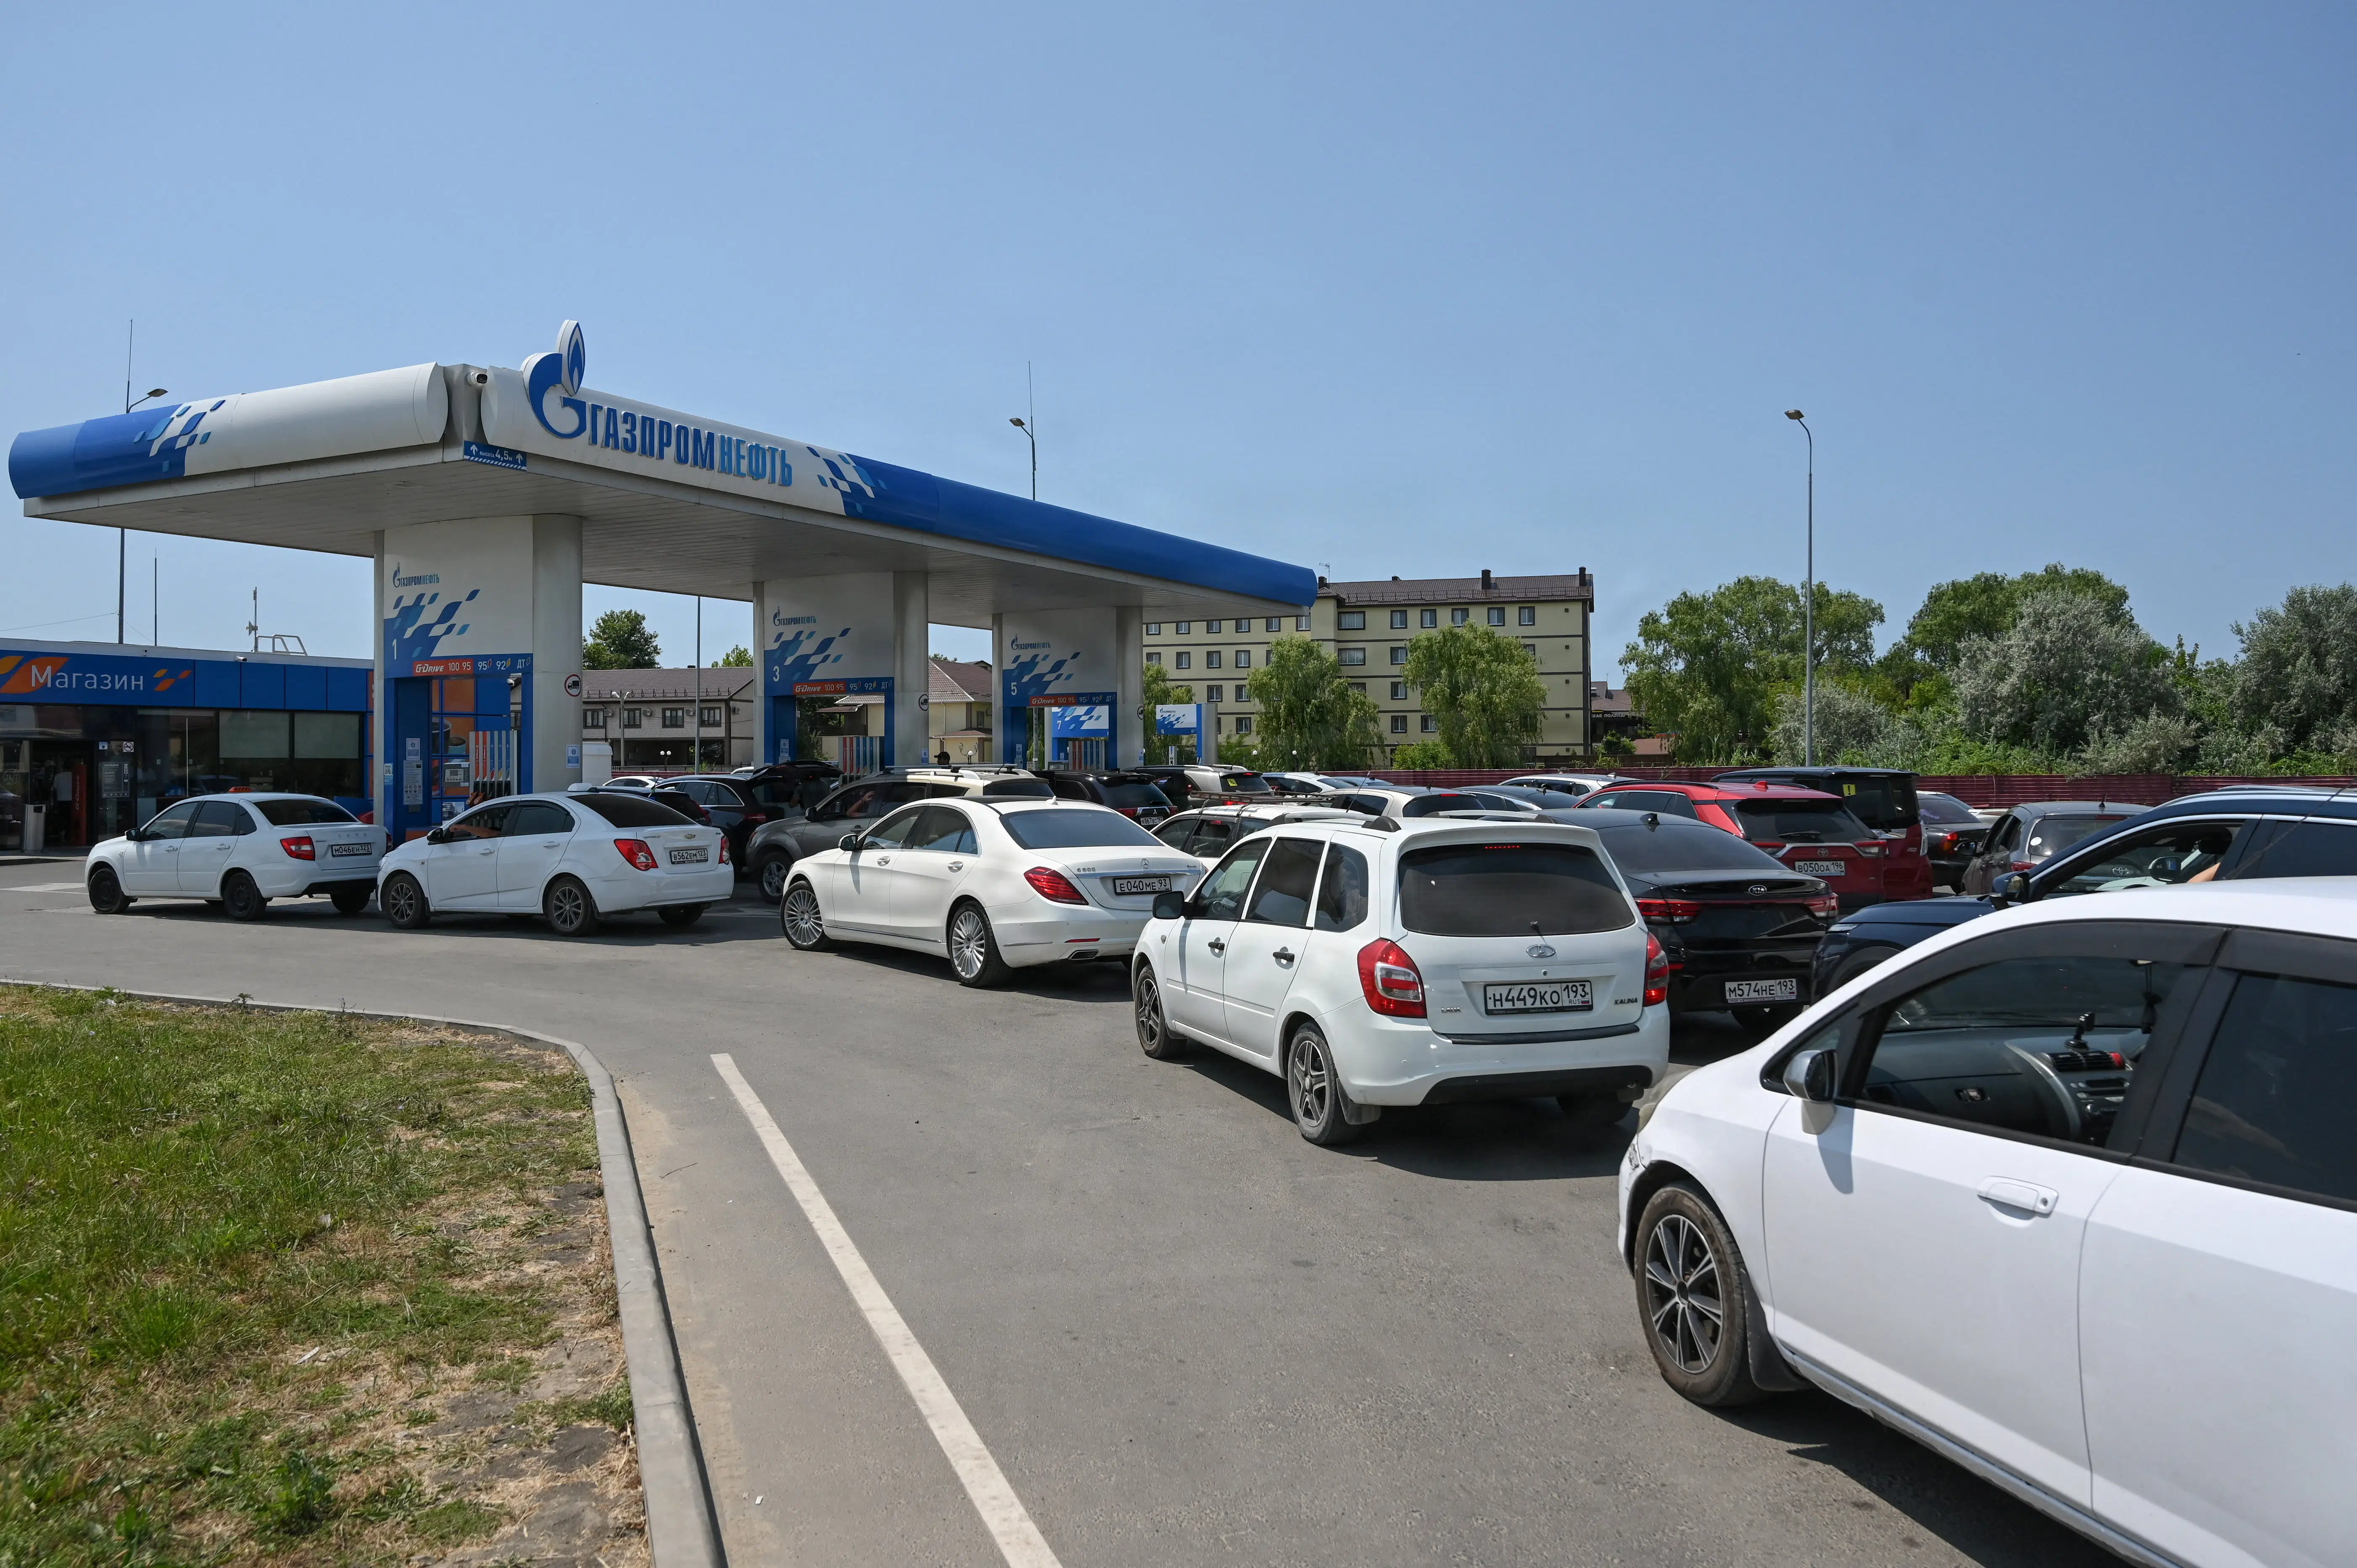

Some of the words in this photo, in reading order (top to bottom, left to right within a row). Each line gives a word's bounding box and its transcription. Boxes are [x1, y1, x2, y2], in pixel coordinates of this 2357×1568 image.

[588, 403, 792, 487] ГАЗПРОМНЕФТЬ
[401, 574, 440, 587] ГАЗПРОМНЕФТЬ
[781, 616, 816, 626] ГАЗПРОМНЕФТЬ
[392, 639, 397, 660] 1
[448, 662, 459, 672] 100
[462, 662, 471, 671] 95
[478, 661, 487, 671] 95
[496, 661, 506, 670] 92
[517, 659, 525, 669] ДТ
[31, 665, 143, 690] Магазин
[773, 666, 780, 682] 3
[1011, 682, 1017, 696] 5
[1057, 720, 1062, 730] 7
[674, 851, 696, 860] В562ЕМ
[1120, 880, 1156, 892] Е040МЕ
[1158, 879, 1167, 887] 93
[1492, 987, 1561, 1008] Н449КО
[1563, 984, 1587, 999] 193
[1728, 983, 1775, 998] М574НЕ
[1777, 980, 1795, 991] 193
